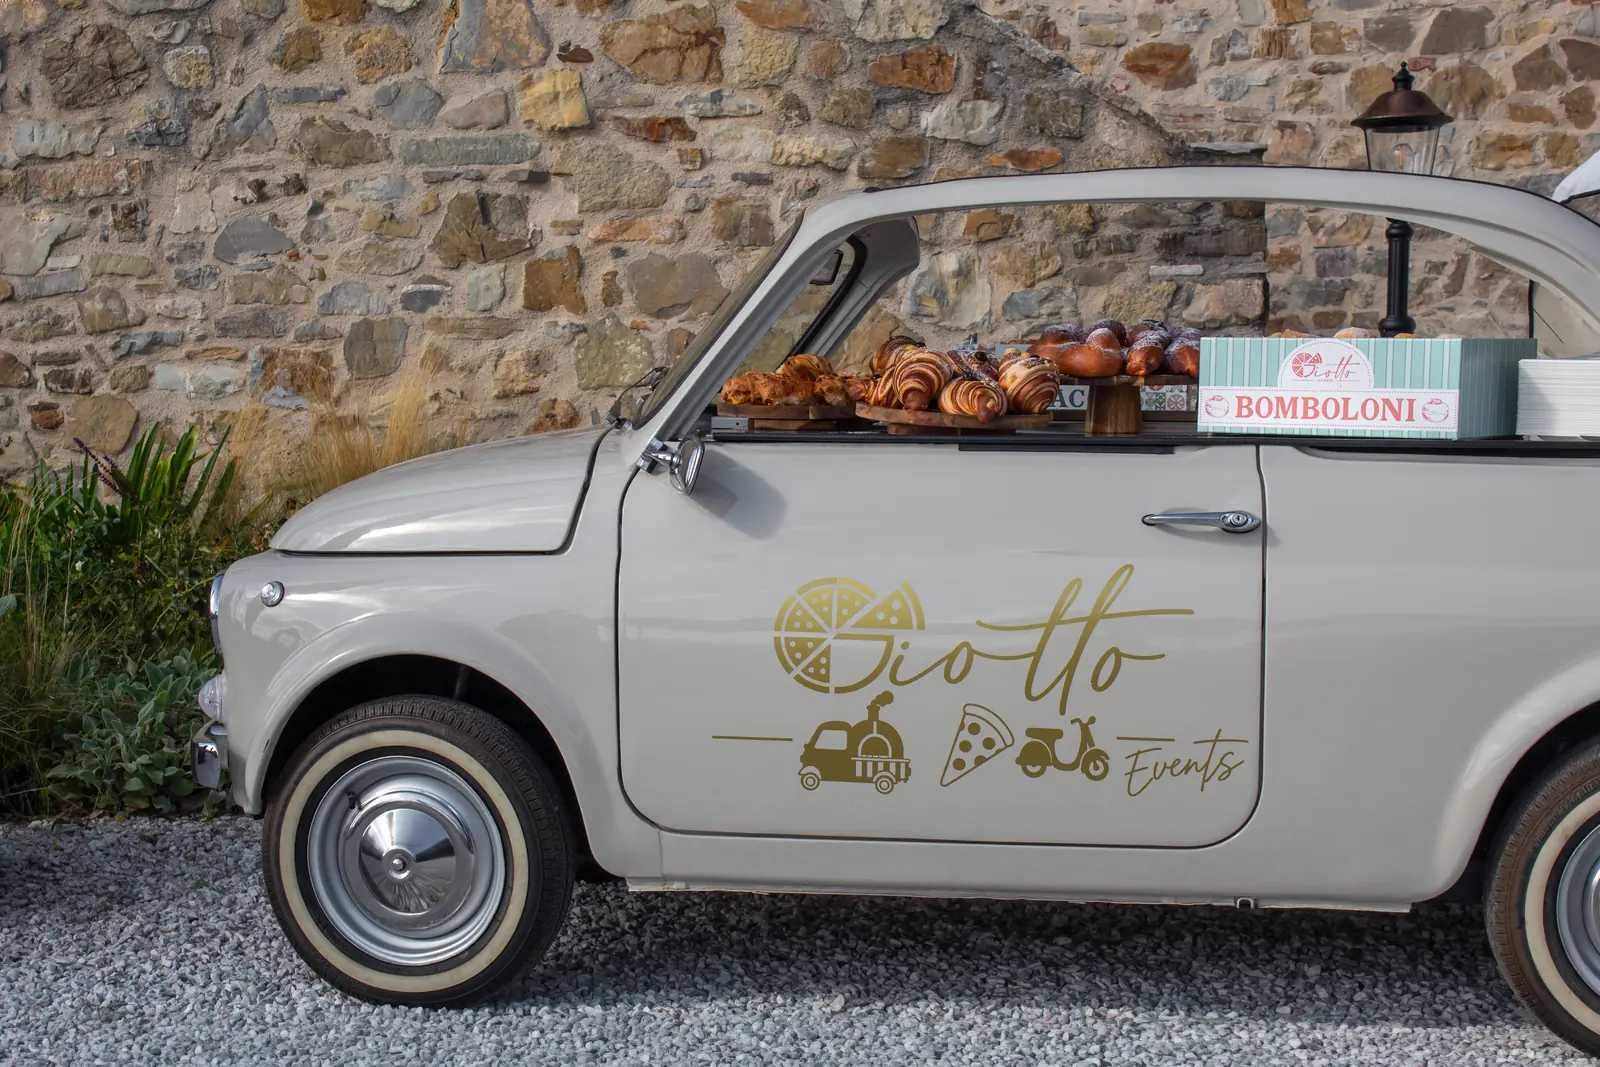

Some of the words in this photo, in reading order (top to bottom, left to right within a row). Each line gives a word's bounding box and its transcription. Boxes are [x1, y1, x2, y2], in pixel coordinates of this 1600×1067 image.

[1291, 352, 1361, 381] Giotto
[1234, 395, 1417, 422] BOMBOLONI
[773, 563, 1194, 716] Giotto
[1124, 728, 1249, 797] Events
